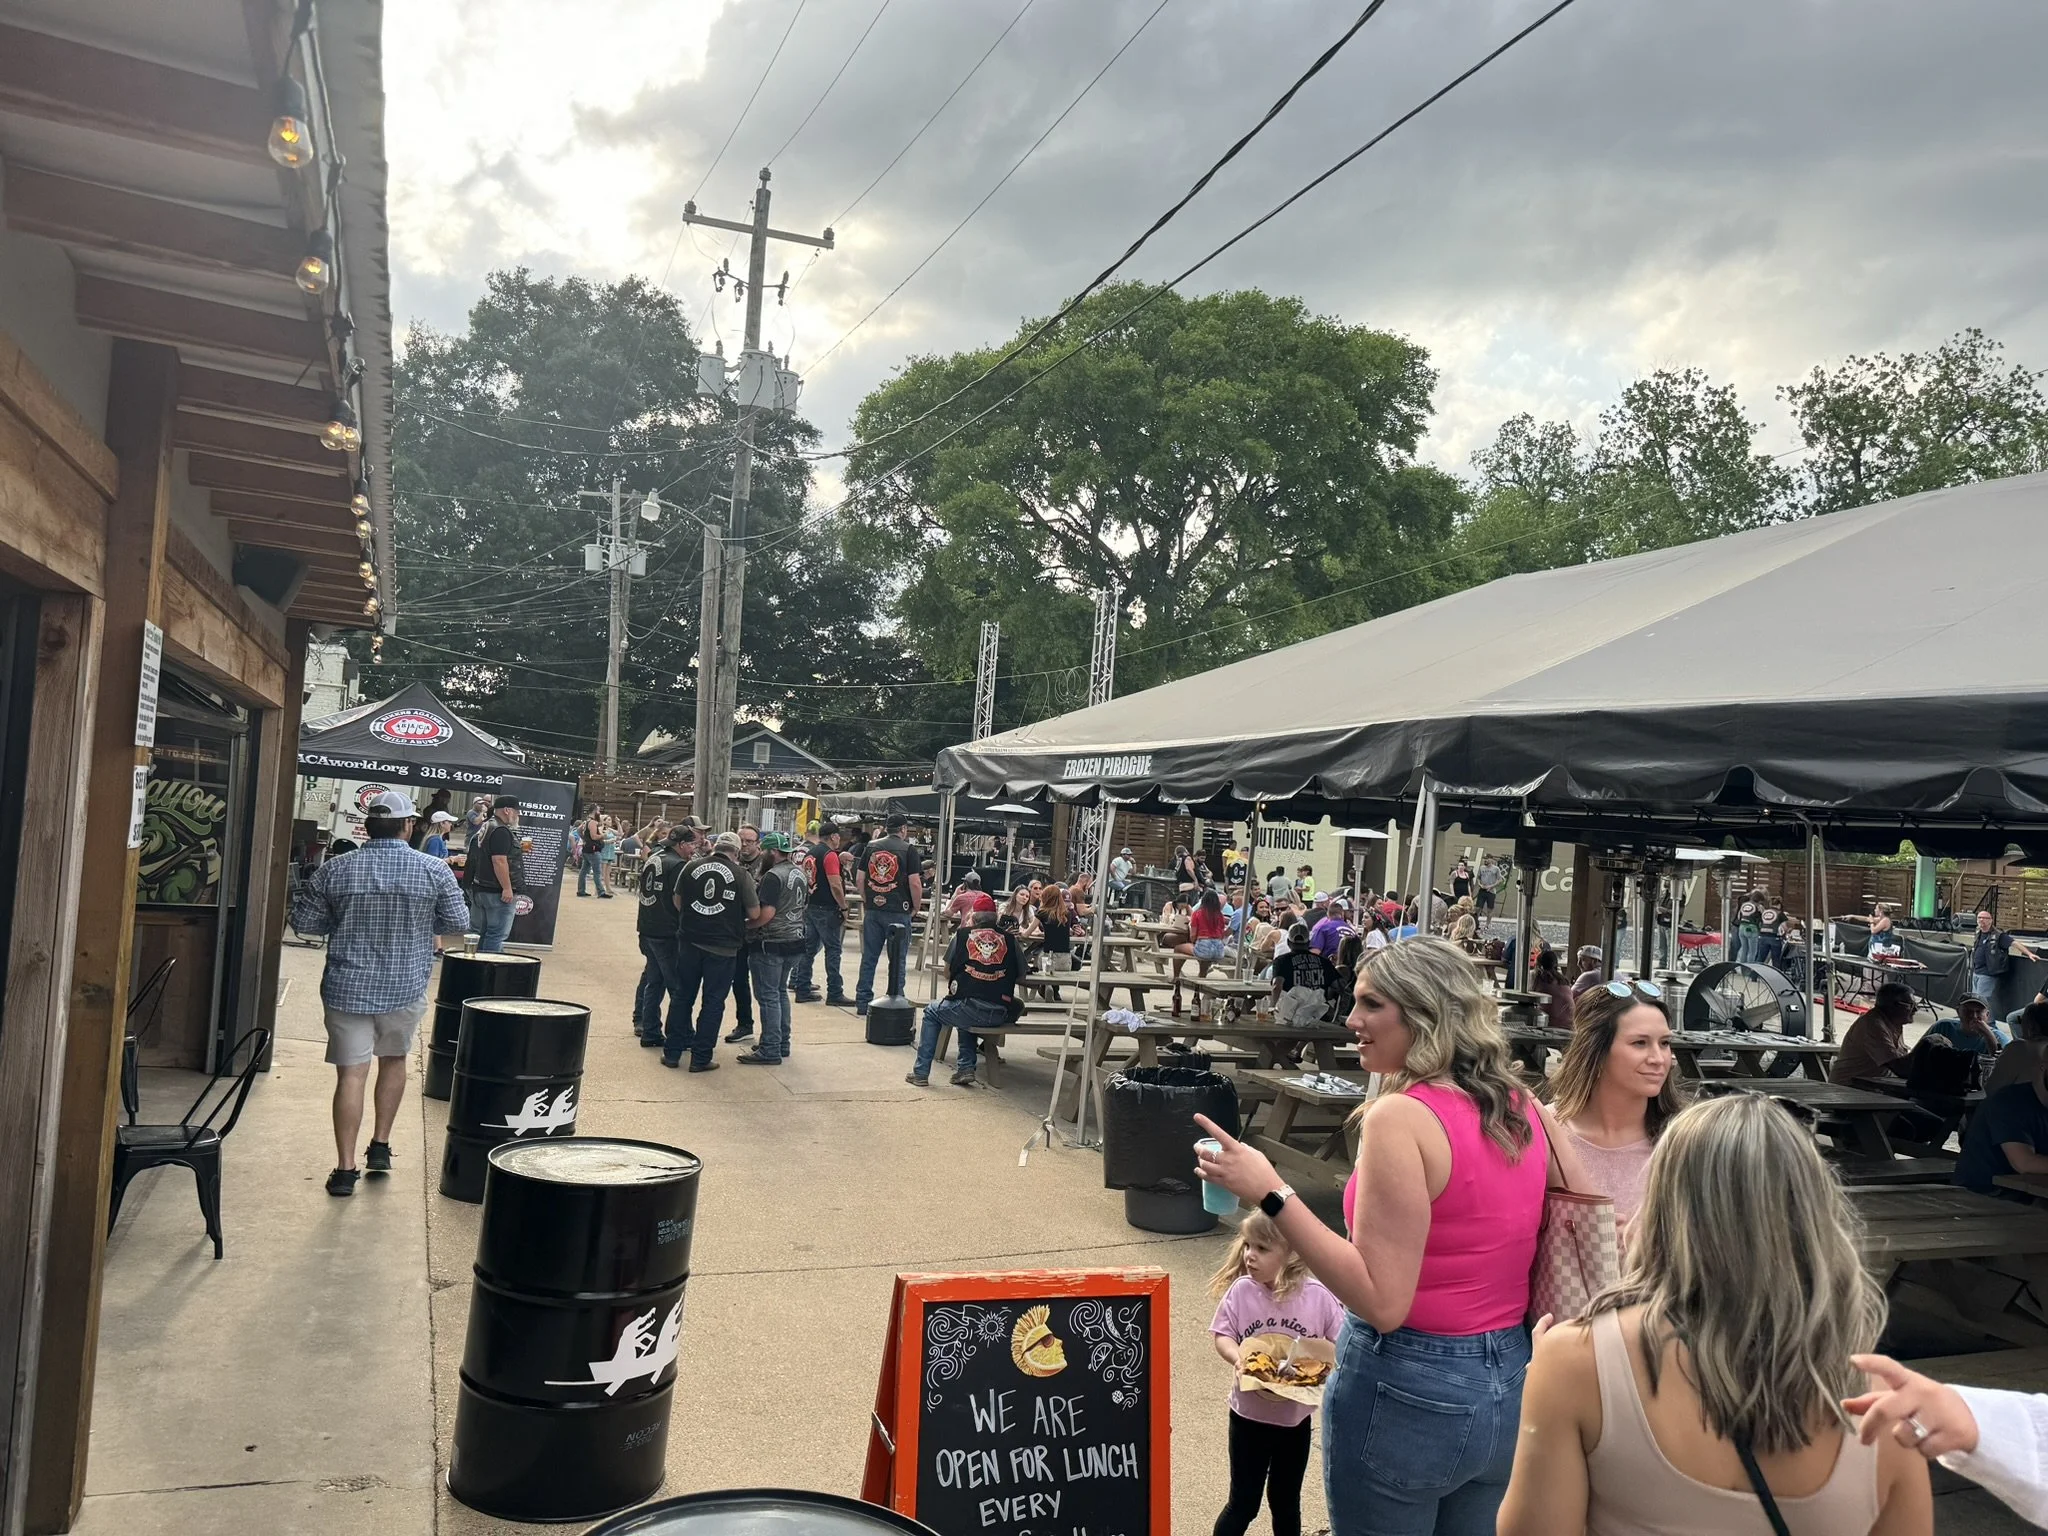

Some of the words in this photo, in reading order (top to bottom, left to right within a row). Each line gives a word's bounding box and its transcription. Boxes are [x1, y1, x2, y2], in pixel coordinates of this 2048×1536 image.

[380, 710, 412, 722] BIKERS
[413, 710, 447, 726] AGAINST
[380, 734, 408, 743] CHILD
[1063, 757, 1102, 777] FROZEN
[1101, 754, 1152, 776] PIROGUE
[145, 778, 226, 824] ayou
[518, 801, 558, 812] ISSION
[724, 890, 735, 899] MC
[1293, 969, 1325, 986] GLOCK
[1266, 1317, 1278, 1328] a
[1281, 1318, 1308, 1336] nice
[969, 1388, 1017, 1434] WE
[1033, 1394, 1087, 1438] ARE
[935, 1448, 1001, 1489] OPEN
[1009, 1444, 1055, 1484] FOR
[1063, 1442, 1139, 1482] LUNCH
[979, 1490, 1062, 1527] EVERY
